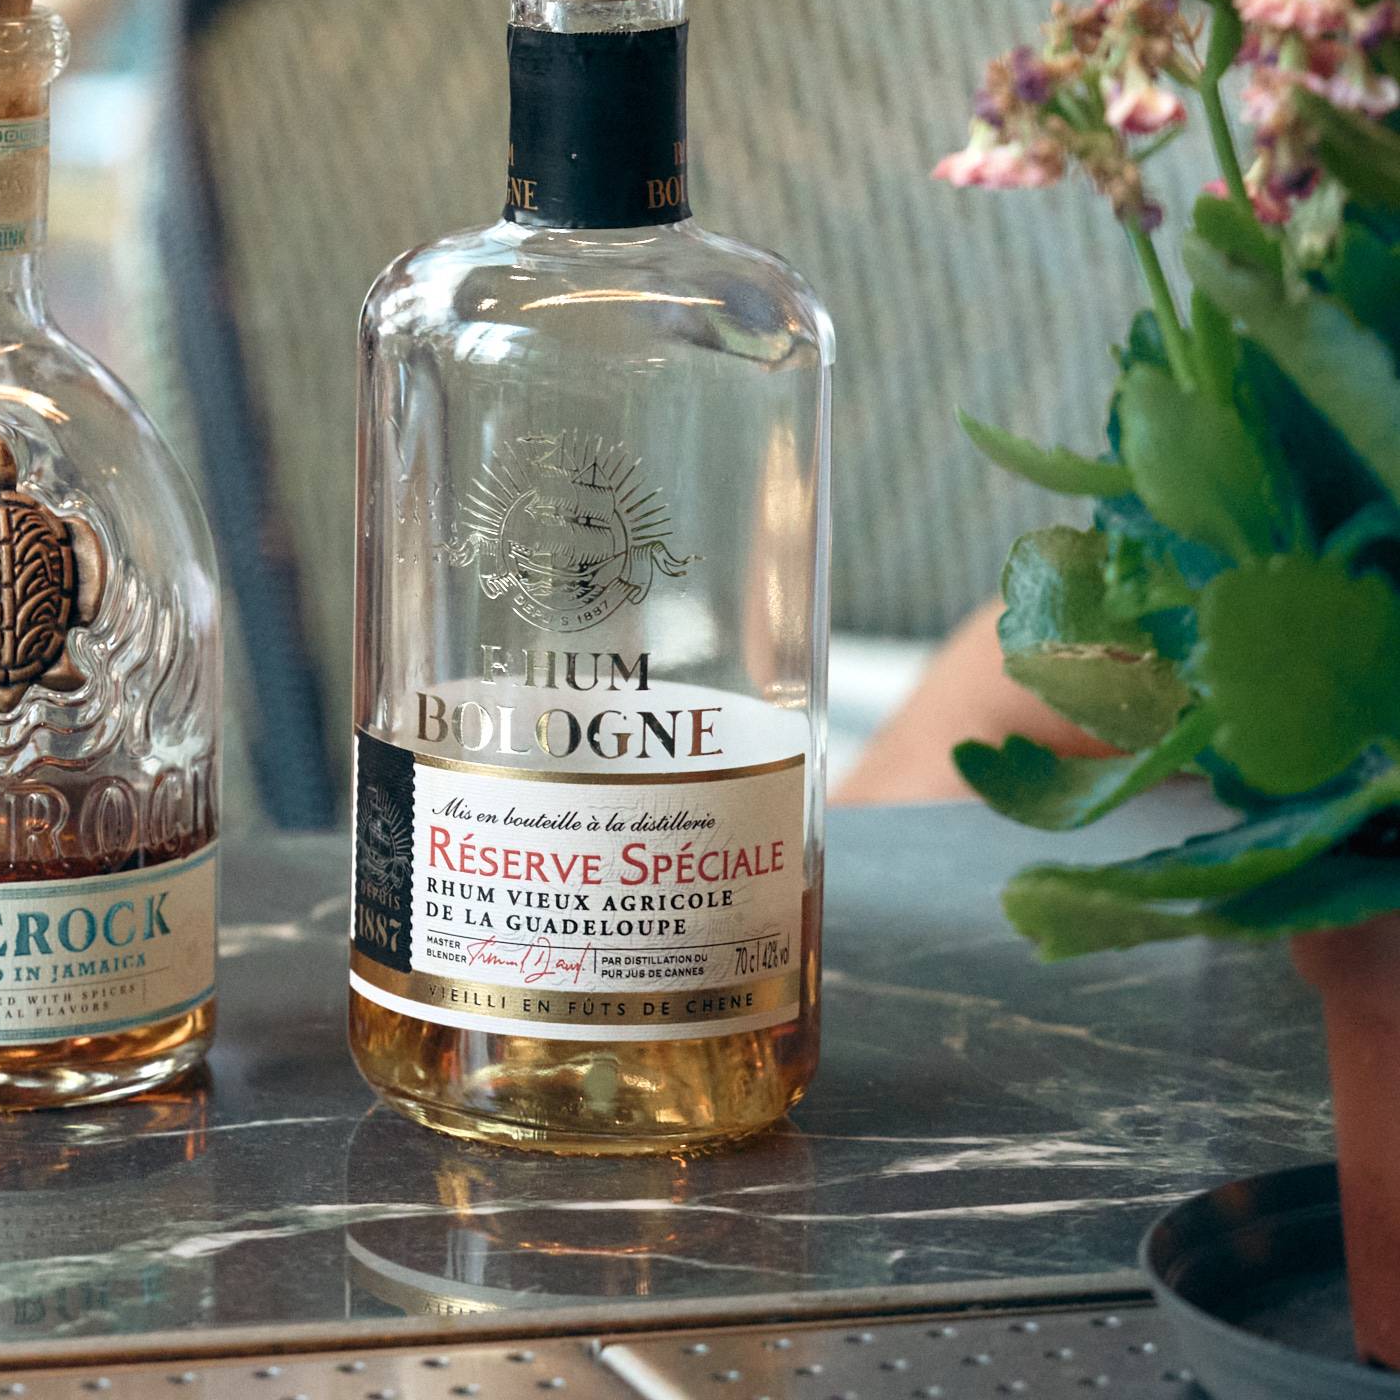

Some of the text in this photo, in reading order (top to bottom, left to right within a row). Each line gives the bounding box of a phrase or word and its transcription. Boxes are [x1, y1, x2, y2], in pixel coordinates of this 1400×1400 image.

[577, 600, 609, 624] 1887
[480, 644, 651, 691] RHUM
[416, 691, 723, 760] BOLOGNE
[432, 797, 716, 831] Mis en bouteille à la distillerie
[427, 877, 733, 912] RHUM VIEUX AGRICOLE
[358, 903, 402, 953] 1887
[426, 902, 687, 937] DE LA GUADELOUPE
[427, 935, 461, 949] MASTER
[427, 949, 467, 963] BLENDER
[14, 967, 41, 982] IN
[51, 952, 146, 983] JAMAICA
[601, 967, 705, 979] PUR JUS DE CANNES
[602, 954, 708, 966] PAR DISTILLATION DU
[736, 946, 748, 975] 70
[27, 993, 72, 1006] WITH
[82, 983, 136, 1000] SPICES
[36, 1001, 109, 1017] FLAVORS
[428, 984, 507, 1009] VIEILLI
[522, 996, 551, 1013] EN
[568, 996, 627, 1016] FÛTS
[643, 1000, 670, 1016] DE
